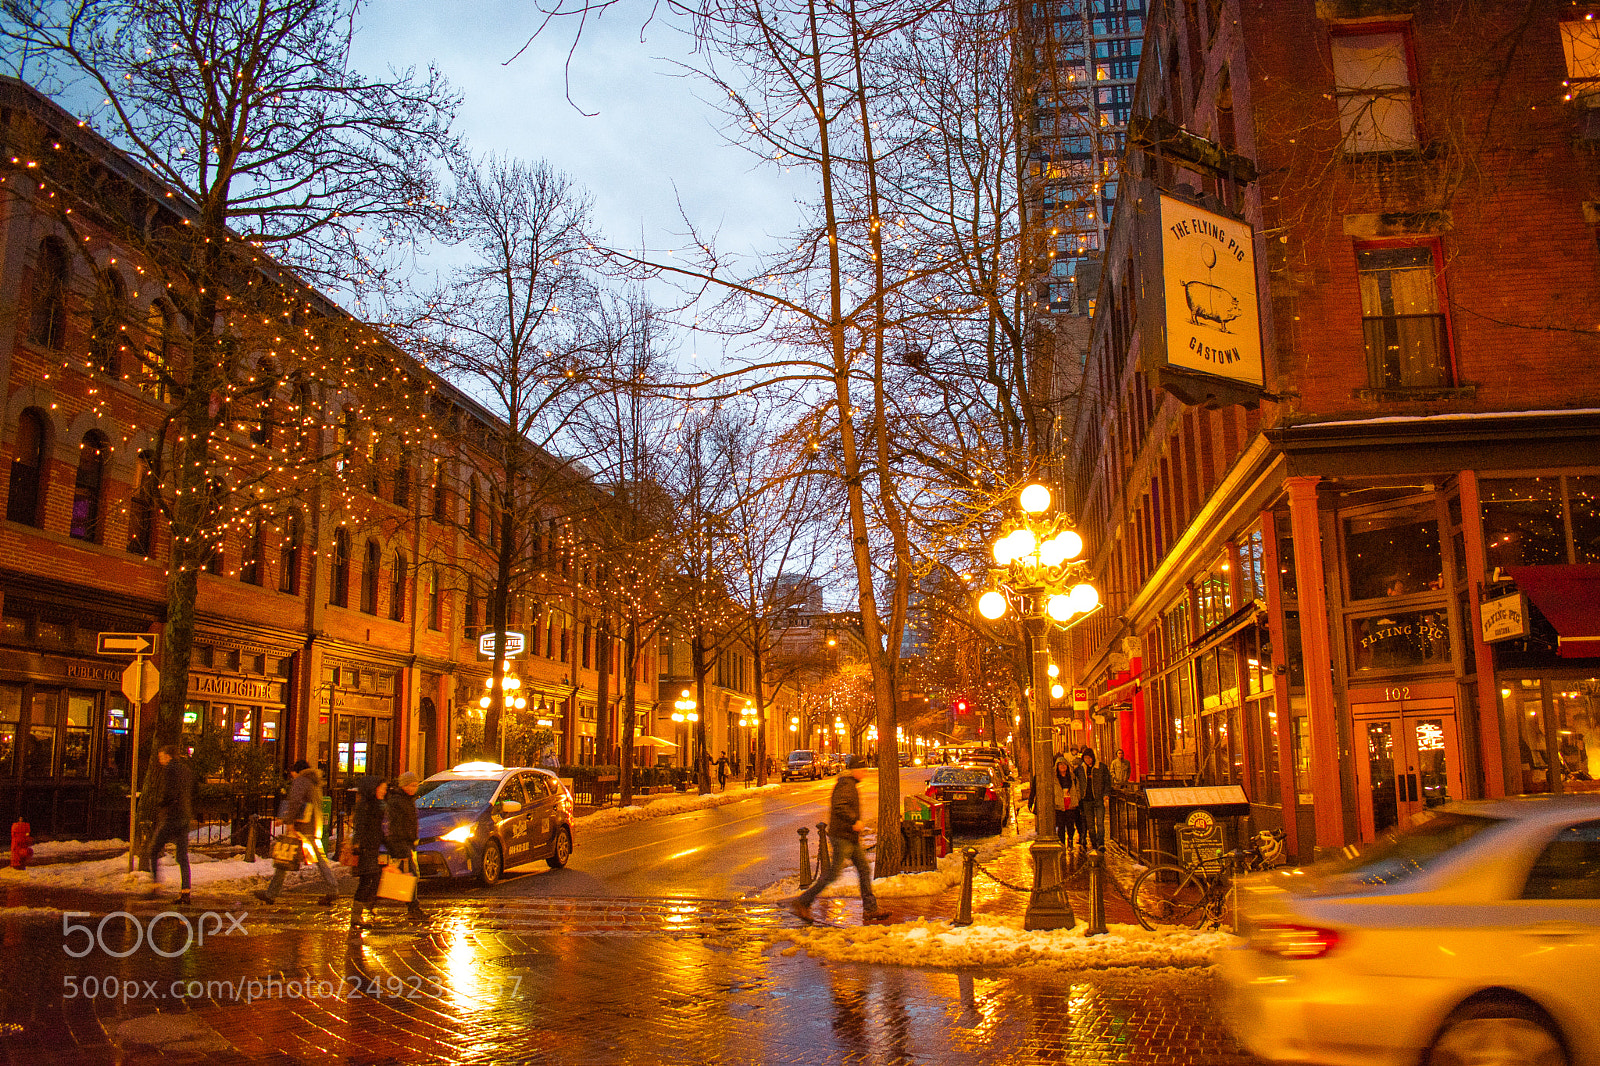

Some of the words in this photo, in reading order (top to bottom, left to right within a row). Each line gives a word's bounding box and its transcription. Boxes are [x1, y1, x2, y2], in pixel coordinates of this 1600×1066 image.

[1171, 220, 1190, 241] THE
[1192, 218, 1225, 243] FLYING
[1227, 238, 1245, 262] PIG
[1189, 336, 1241, 364] GASTOWN
[1360, 624, 1412, 648] FLYING
[1418, 625, 1444, 640] PIG
[68, 665, 102, 679] PUBLIC
[196, 677, 272, 699] LAMPLIGHTER
[1384, 687, 1411, 701] 102
